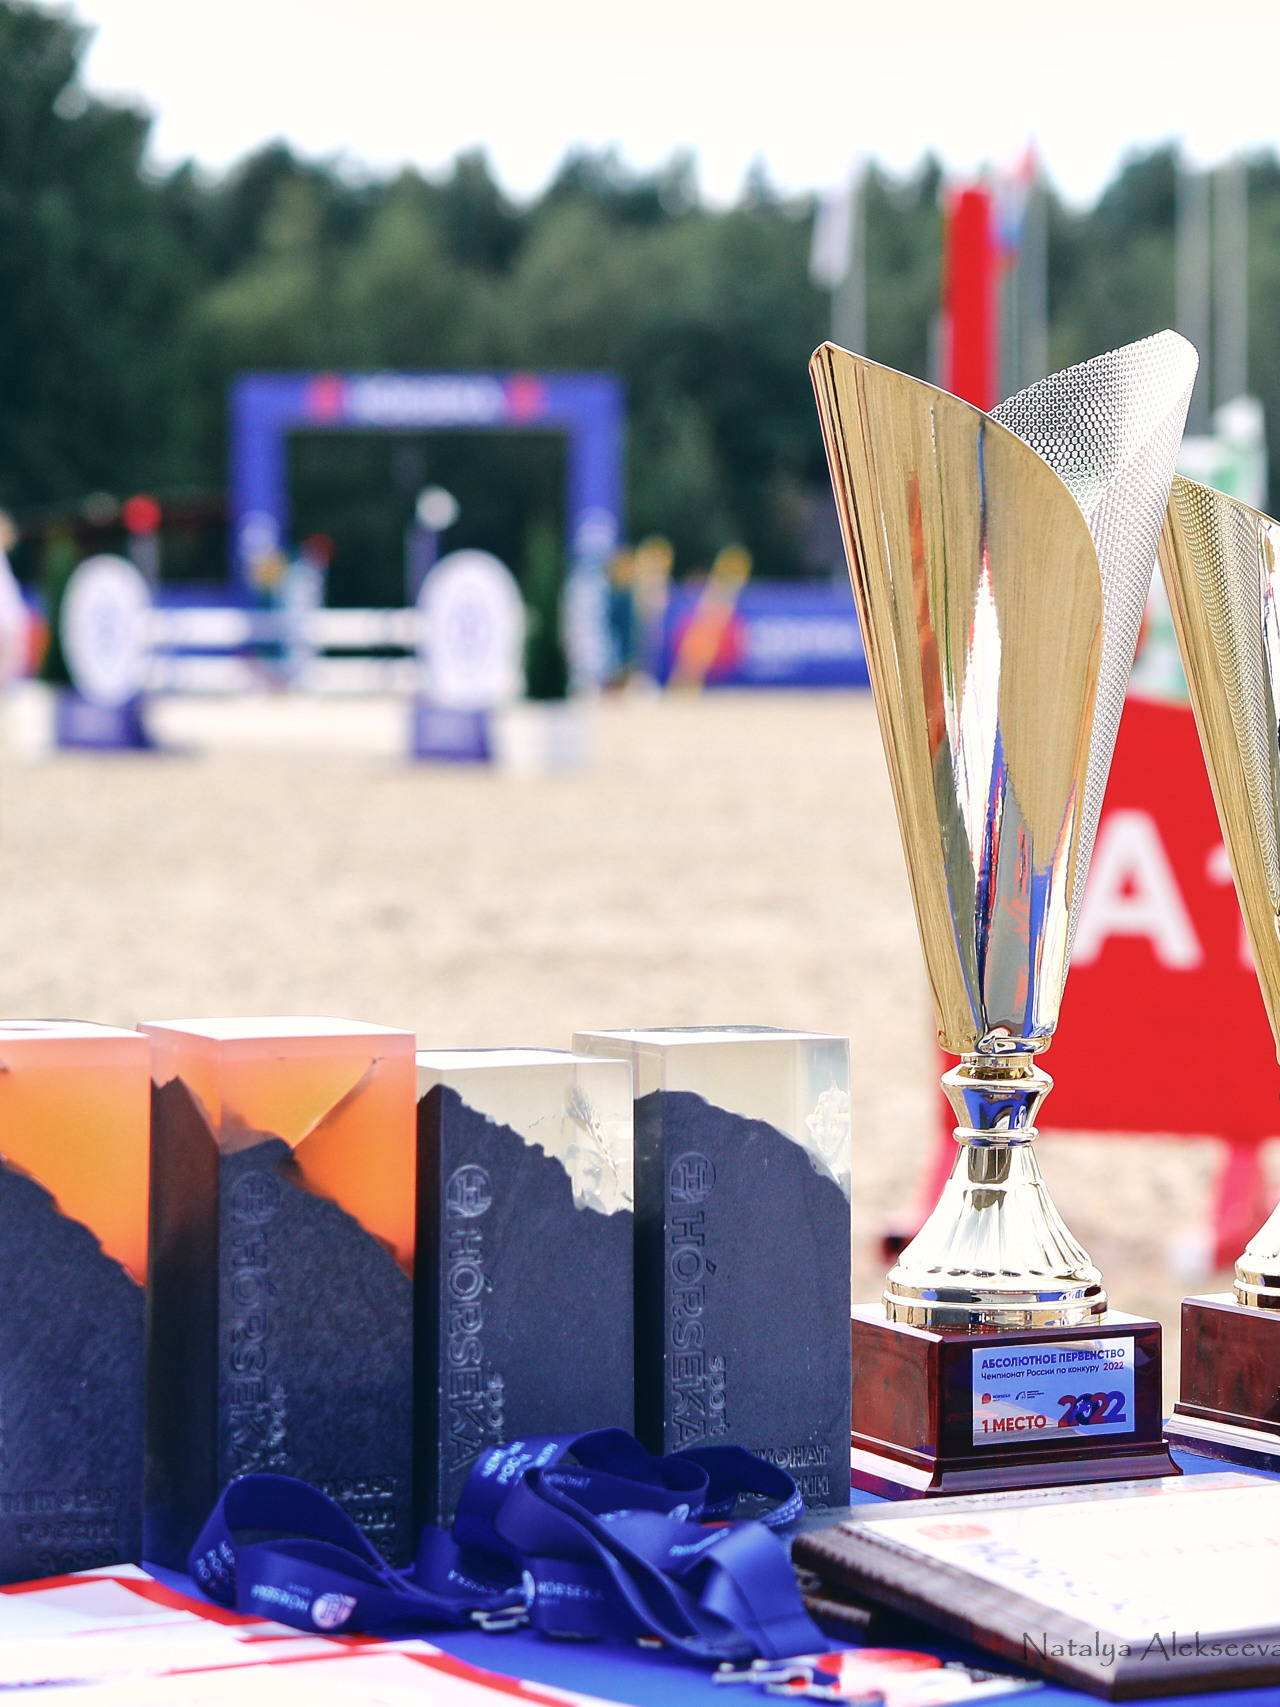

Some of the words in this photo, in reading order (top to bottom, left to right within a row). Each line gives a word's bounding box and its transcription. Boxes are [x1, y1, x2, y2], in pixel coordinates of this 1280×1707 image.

[981, 1353, 1057, 1370] АБСОЛЮТНОЕ
[1058, 1348, 1125, 1364] ПЕРВЕНСТВО
[981, 1371, 1025, 1381] Чемпионат
[1026, 1368, 1055, 1377] России
[1056, 1367, 1066, 1375] по
[1068, 1365, 1100, 1375] конкуру
[1103, 1361, 1124, 1371] 2022
[1057, 1390, 1127, 1428] 2022
[982, 1419, 989, 1433] 1
[993, 1414, 1047, 1432] МЕСТО
